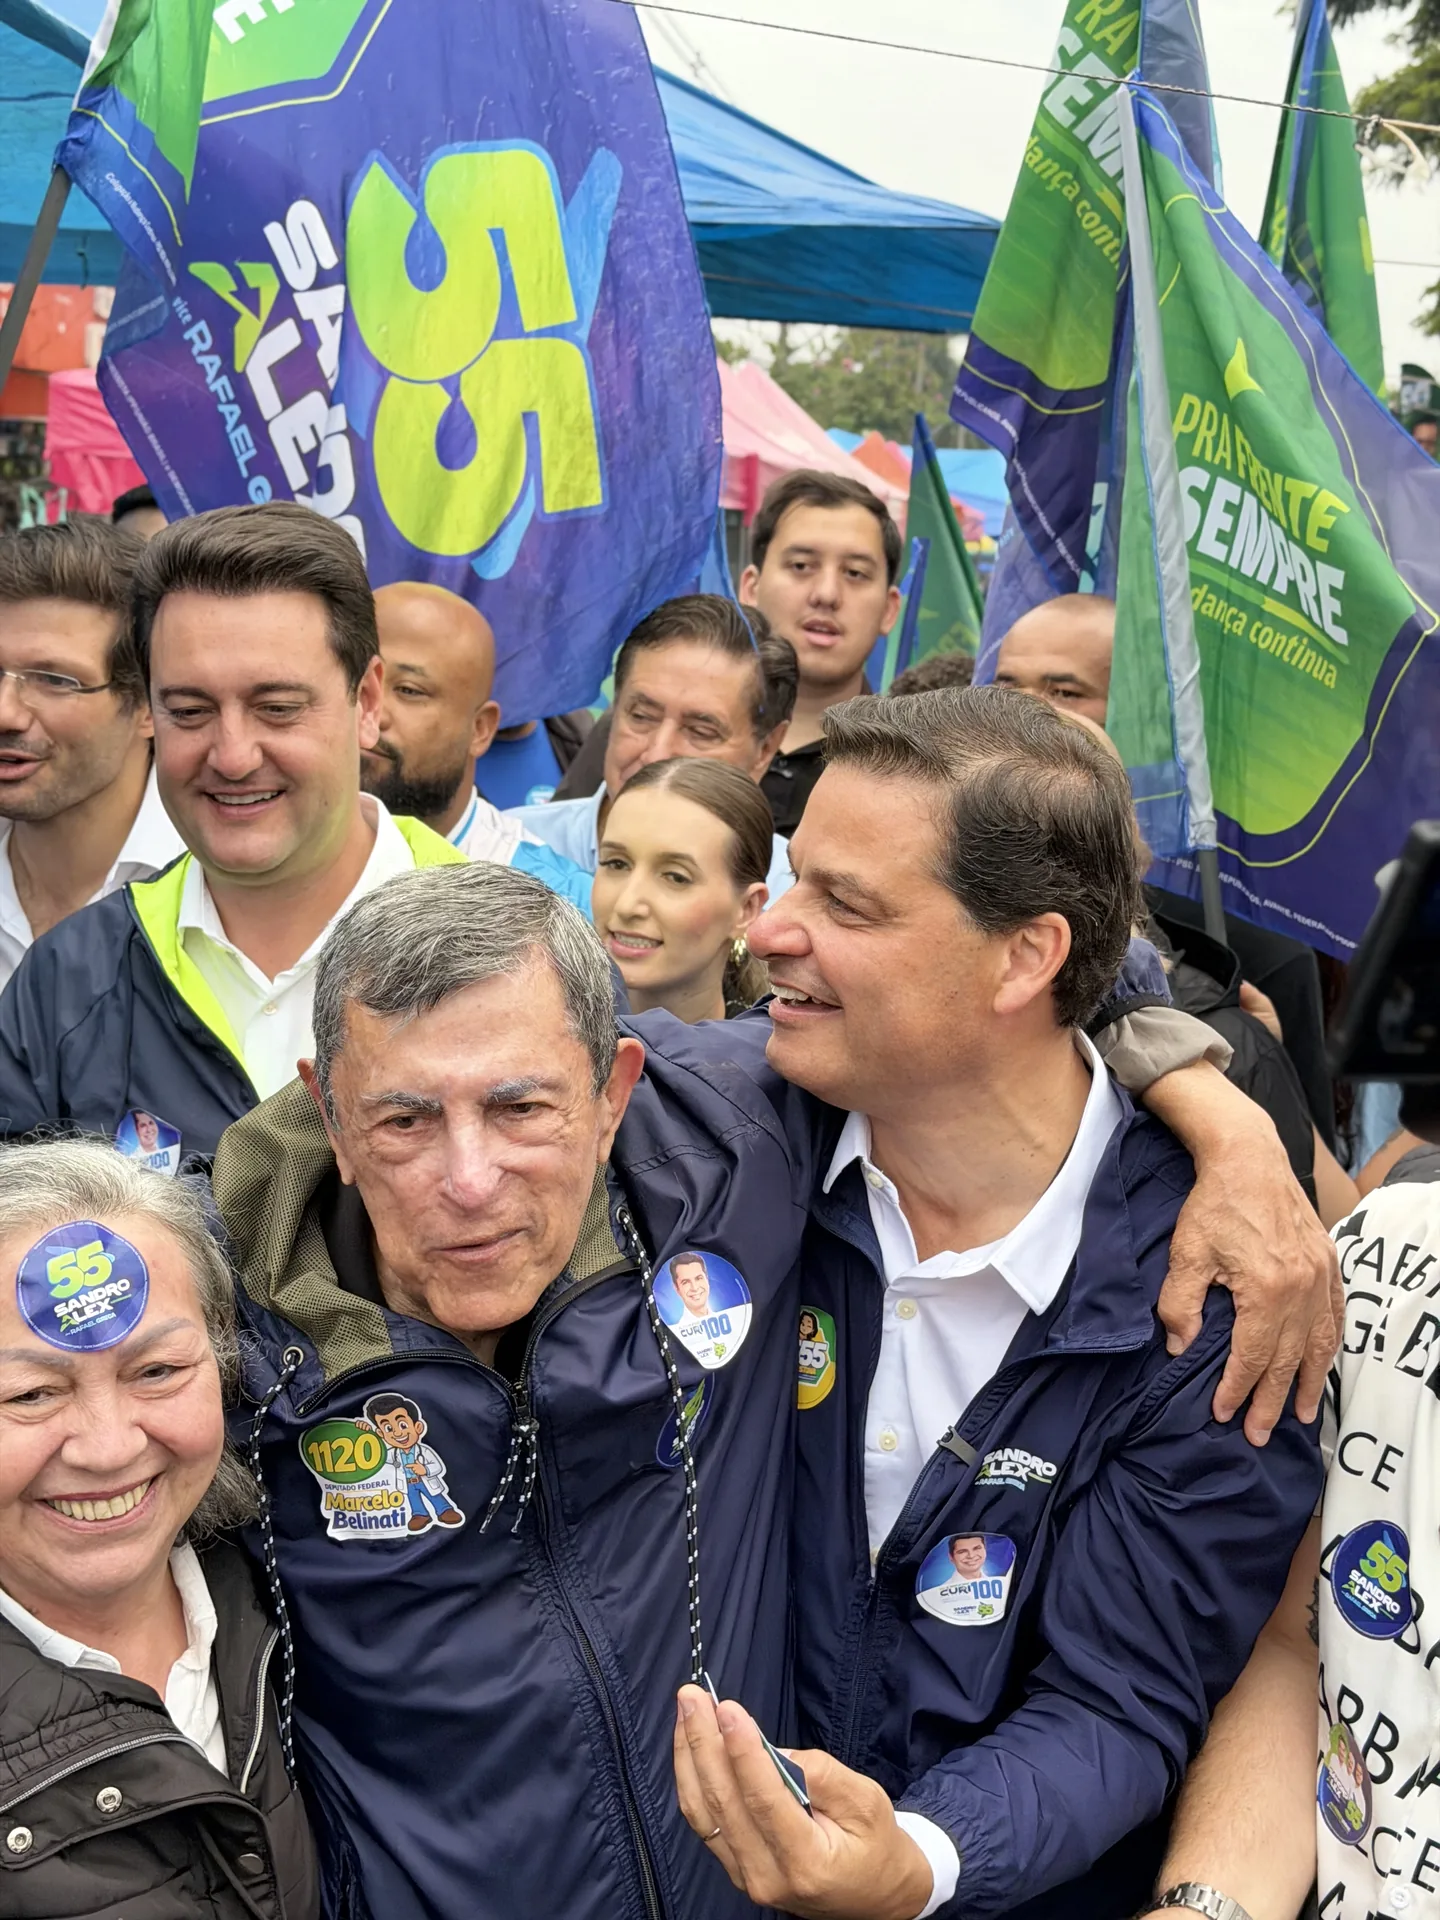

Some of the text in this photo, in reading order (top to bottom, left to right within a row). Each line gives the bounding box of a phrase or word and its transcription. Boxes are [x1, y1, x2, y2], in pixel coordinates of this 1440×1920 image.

[346, 147, 604, 556] 55
[172, 296, 192, 325] vice
[183, 320, 257, 479] RAFAEL
[1173, 392, 1232, 471] PRA
[1179, 466, 1349, 646] SEMPRE
[1191, 583, 1338, 690] dança continua
[46, 1240, 113, 1299] 55
[53, 1278, 131, 1318] SANDRO
[680, 1313, 731, 1340] CURI 100
[799, 1340, 828, 1369] 55
[307, 1432, 382, 1473] 1120
[983, 1447, 1057, 1477] SANDRO
[324, 1479, 391, 1491] DEPUTADO FEDERAL
[325, 1489, 404, 1512] Marcelo
[332, 1506, 406, 1531] Belinati
[1360, 1540, 1408, 1593] 55
[939, 1579, 1003, 1600] CURI 100
[1348, 1569, 1401, 1615] SANDRO
